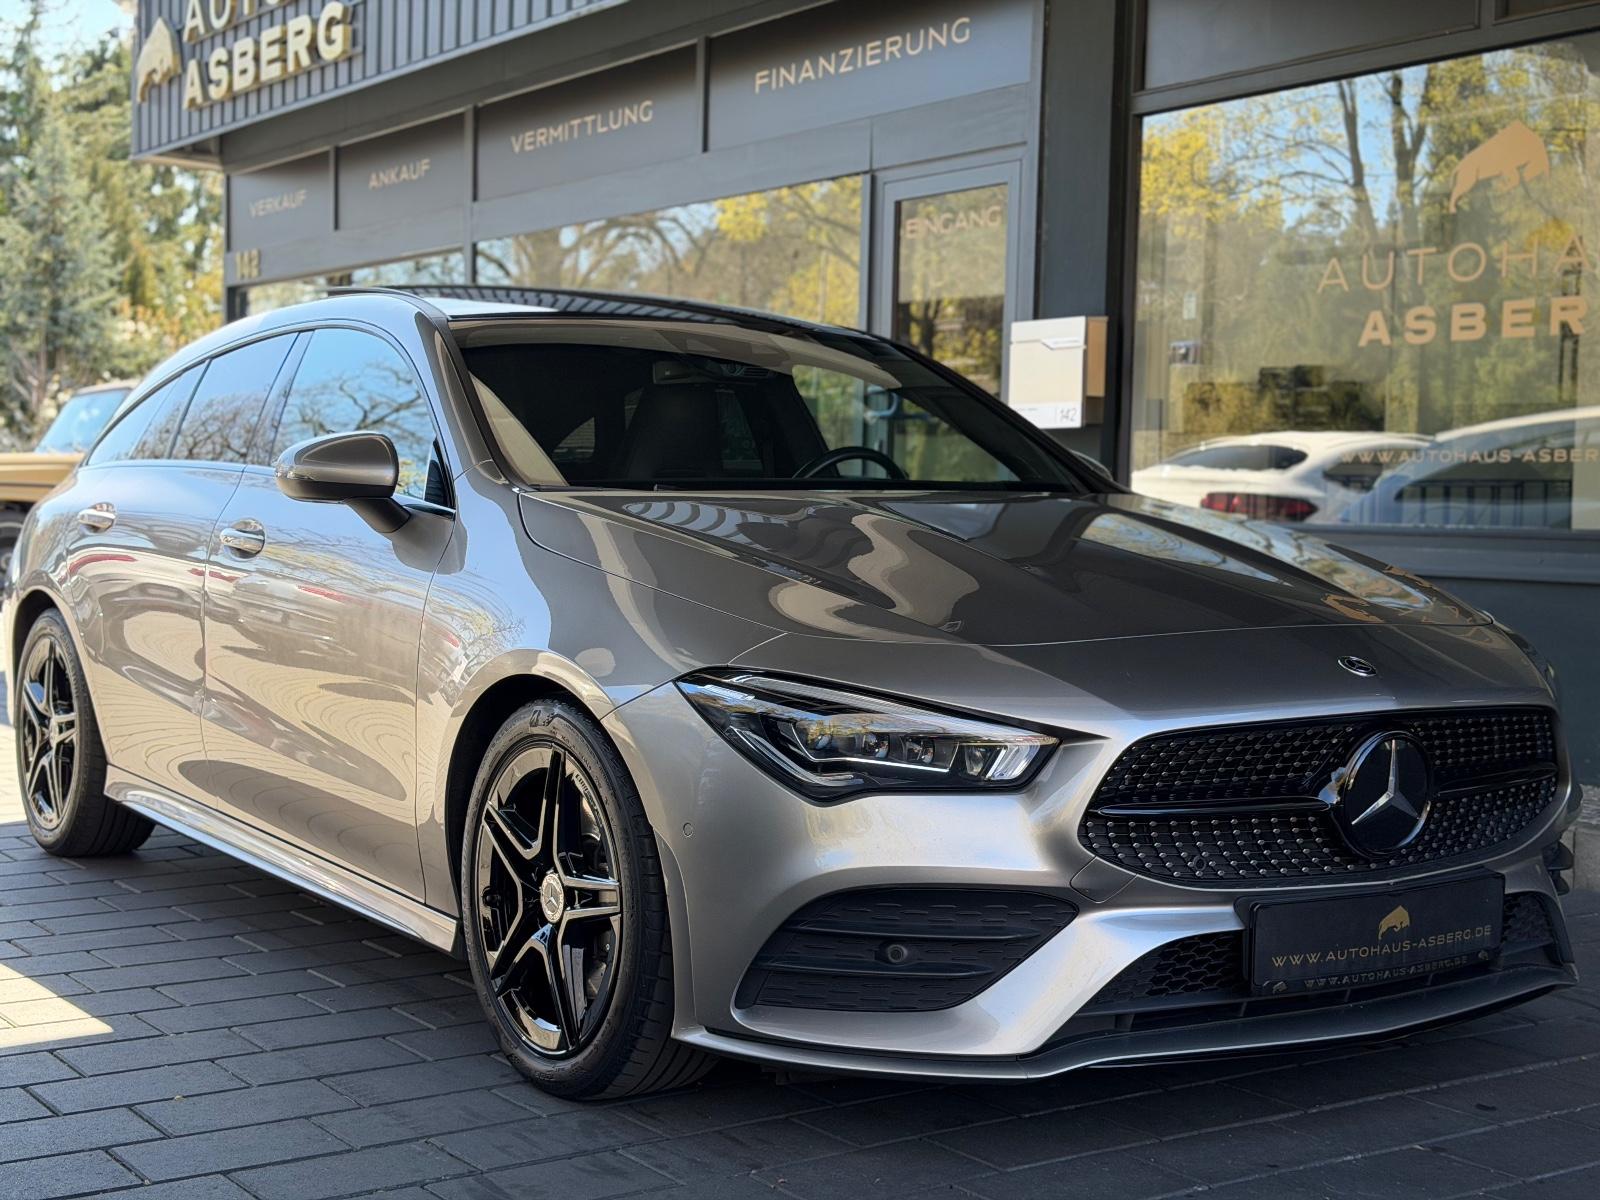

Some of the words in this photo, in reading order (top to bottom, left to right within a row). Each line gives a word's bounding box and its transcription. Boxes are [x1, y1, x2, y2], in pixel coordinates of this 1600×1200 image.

[182, 0, 280, 43] AU
[182, 1, 347, 111] ASBERG
[754, 16, 971, 95] FINANZIERUNG
[510, 99, 654, 155] VERMITTLUNG
[368, 158, 431, 190] ANKAUF
[249, 189, 308, 219] VERKAUF
[905, 204, 1003, 240] EINGANG
[1357, 295, 1589, 348] ASBER
[1271, 924, 1492, 968] WWW.AUTOHAUS-ASBERG.DE
